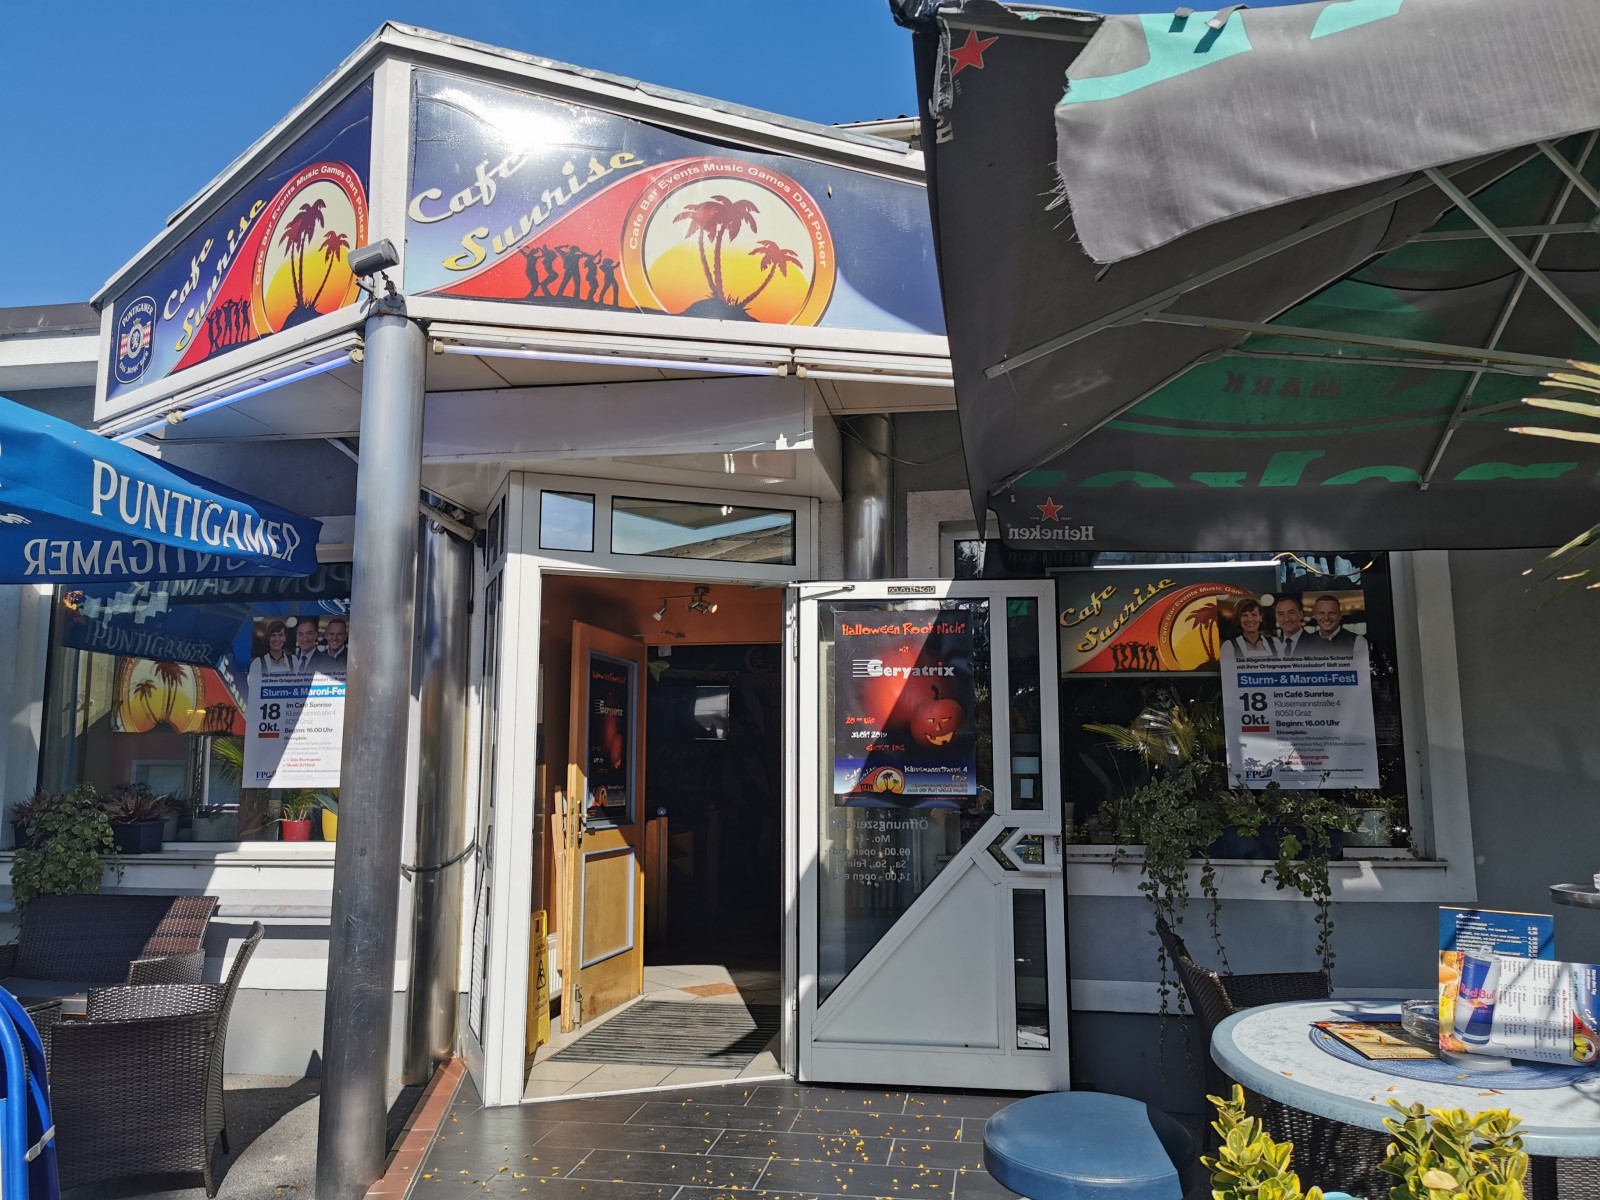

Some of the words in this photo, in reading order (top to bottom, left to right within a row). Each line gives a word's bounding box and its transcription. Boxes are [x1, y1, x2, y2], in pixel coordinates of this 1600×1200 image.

[442, 152, 645, 271] Sunrise
[629, 214, 645, 250] Cafe
[640, 188, 659, 210] Bar
[657, 165, 700, 189] Events
[703, 163, 744, 173] Music
[747, 167, 791, 194] Games
[791, 191, 815, 220] Dart
[811, 220, 827, 268] Poker
[255, 263, 264, 286] Cafe
[261, 222, 274, 246] Bar
[272, 186, 296, 221] Events
[296, 166, 320, 187] Music
[320, 164, 346, 179] Games
[345, 174, 359, 197] Dart
[355, 197, 365, 242] Poker
[162, 238, 214, 321] Cafe
[175, 200, 267, 352] Sunrise
[121, 303, 154, 327] PUNTIGAMER
[91, 459, 301, 562] PUNTIGAMER
[1059, 584, 1117, 628] Cafe
[1175, 590, 1198, 607] Events
[1224, 587, 1244, 596] Gam
[1076, 577, 1177, 652] Sunrise
[841, 624, 900, 636] Halloween
[91, 621, 213, 664] PUNTIGAMER
[866, 660, 955, 679] Geryatrix
[1240, 675, 1278, 685] Sturm-
[1279, 675, 1289, 684] &
[1290, 673, 1357, 684] Maroni-Fest
[262, 688, 292, 697] Sturm-
[292, 688, 299, 697] &
[301, 686, 346, 696] Maroni-Fes
[1283, 690, 1302, 699] Café
[1239, 692, 1268, 711] 18
[259, 703, 281, 720] 18
[1241, 714, 1270, 725] Okt.
[1294, 709, 1312, 717] Graz
[259, 722, 281, 732] Okt.
[1276, 719, 1304, 728] Beginn:
[1460, 983, 1479, 998] Red
[1479, 989, 1496, 1000] Bull
